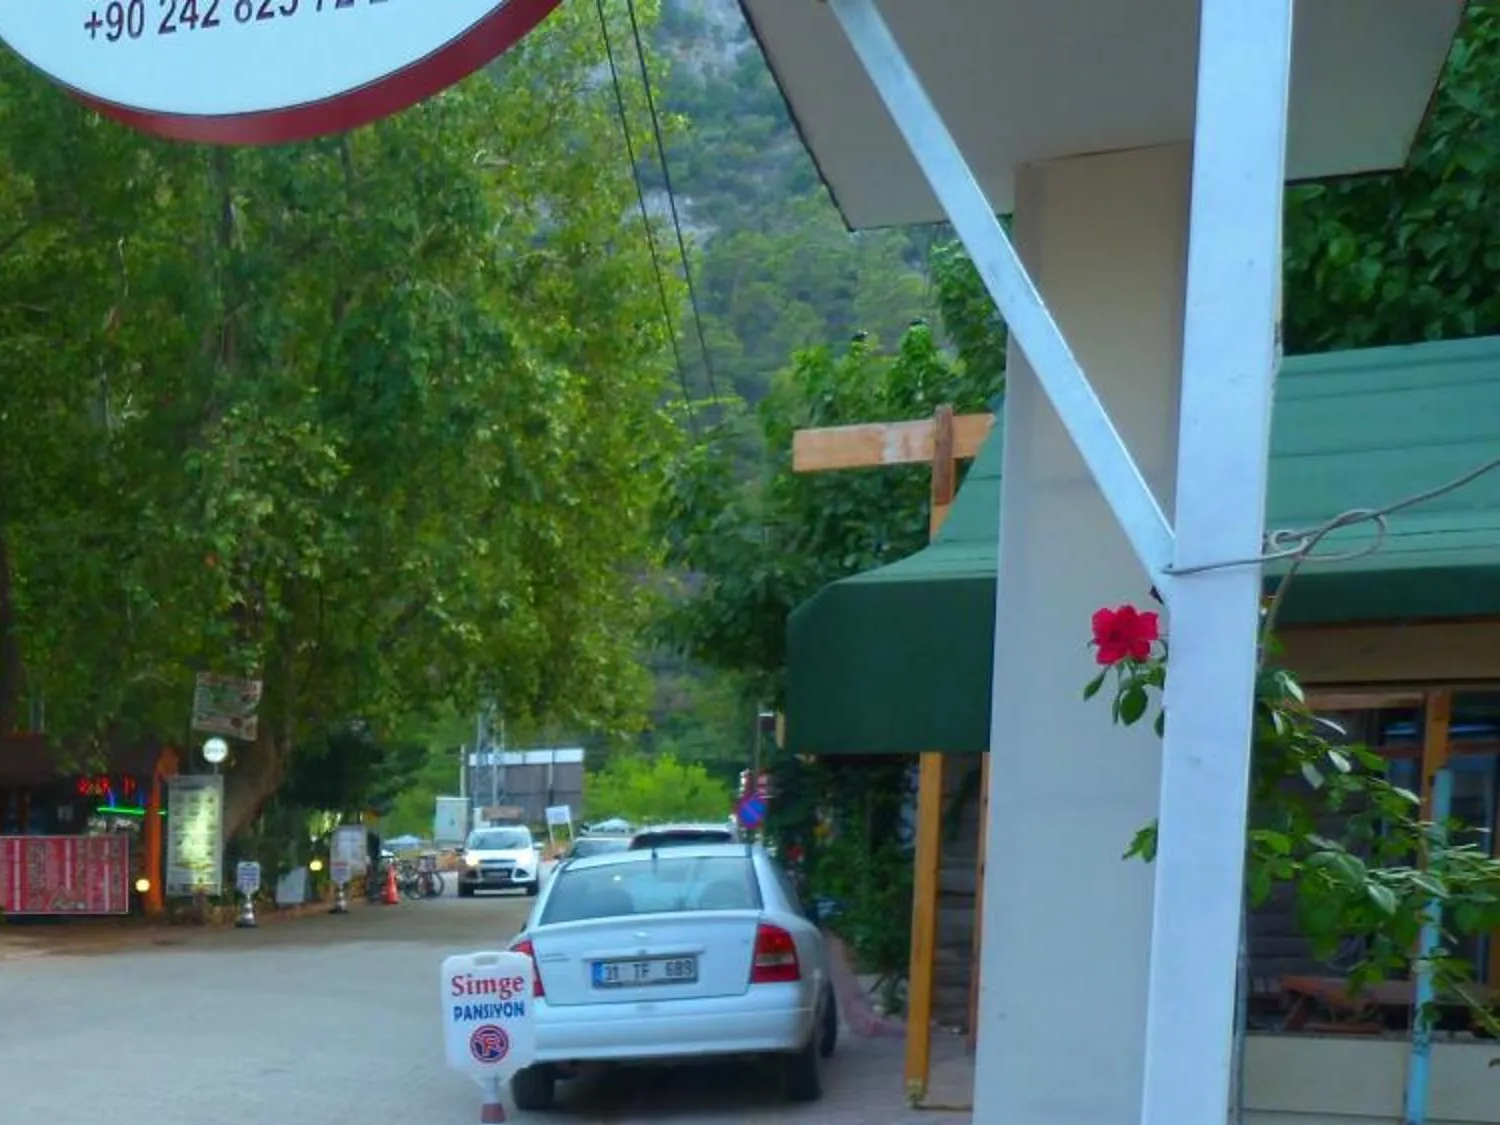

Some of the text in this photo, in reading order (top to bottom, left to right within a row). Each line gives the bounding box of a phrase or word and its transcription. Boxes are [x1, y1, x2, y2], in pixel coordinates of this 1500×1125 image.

[84, 0, 145, 42] +90
[157, 0, 221, 35] 242
[451, 973, 525, 1001] Simge
